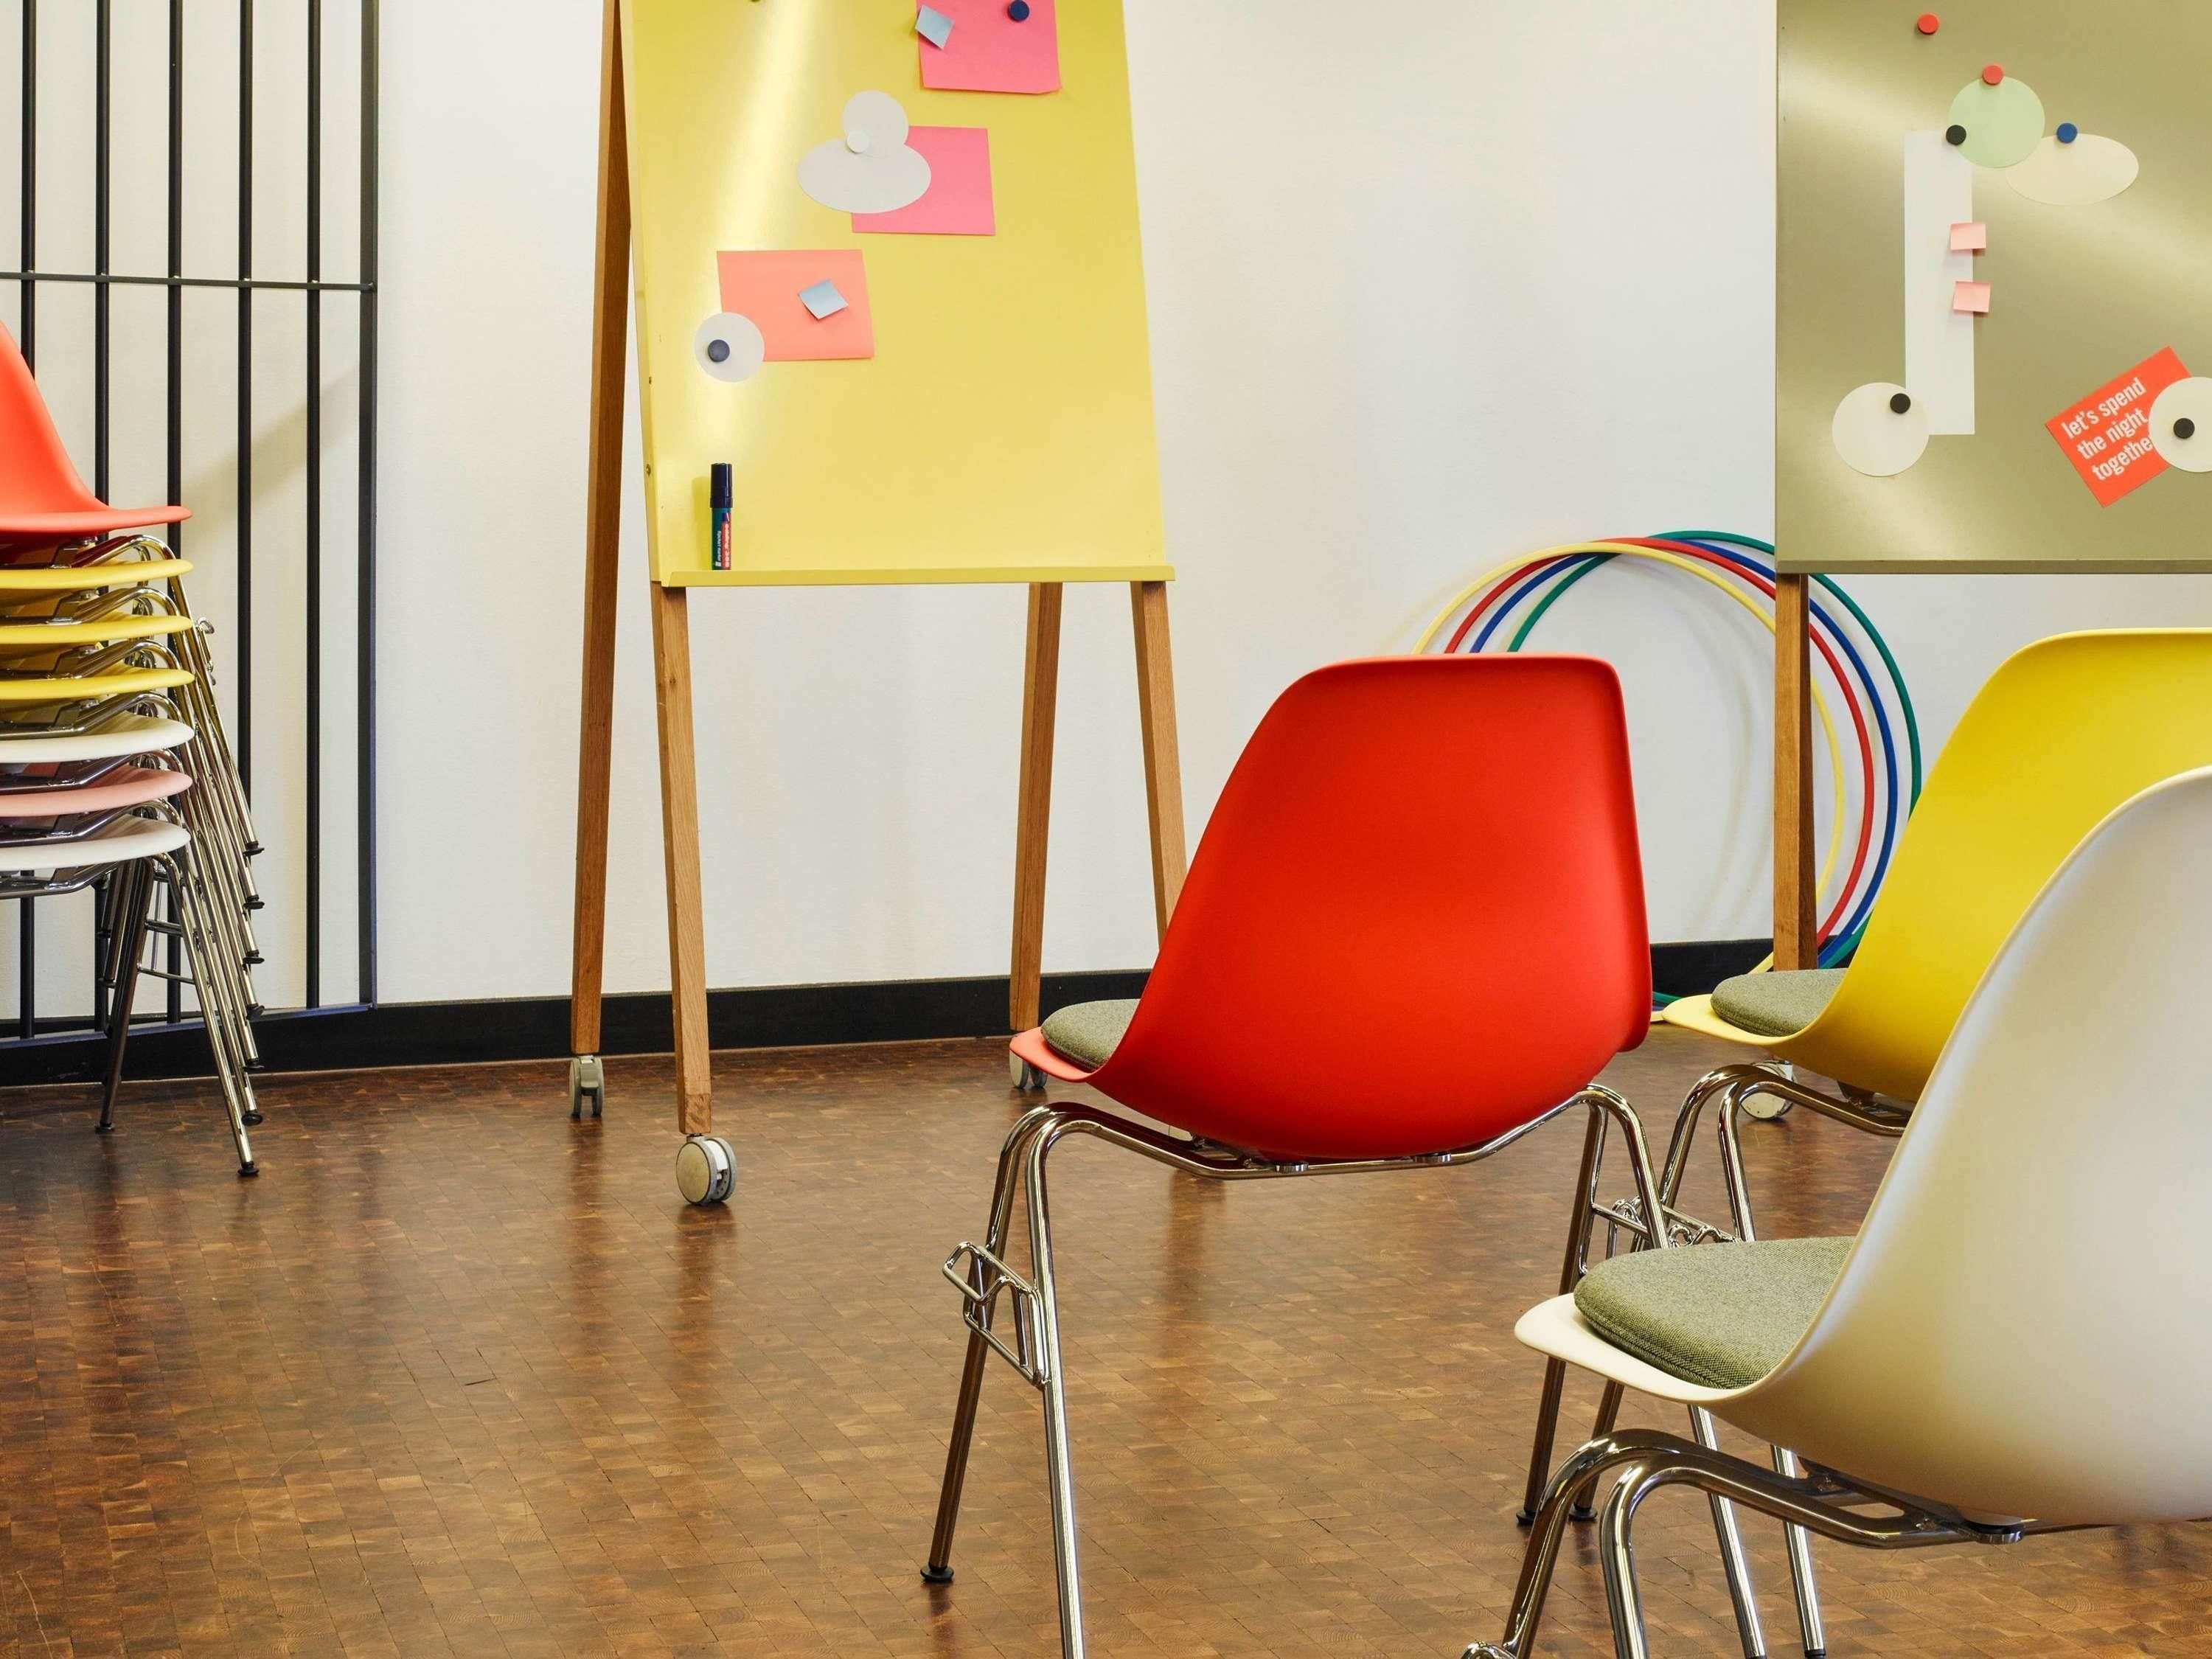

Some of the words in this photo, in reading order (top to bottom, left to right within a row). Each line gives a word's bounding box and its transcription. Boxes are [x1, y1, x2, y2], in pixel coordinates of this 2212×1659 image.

[2062, 410, 2099, 439] let's
[2098, 377, 2146, 417] spend
[2076, 436, 2107, 459] the
[2106, 408, 2149, 442] night
[2092, 437, 2154, 480] togethe
